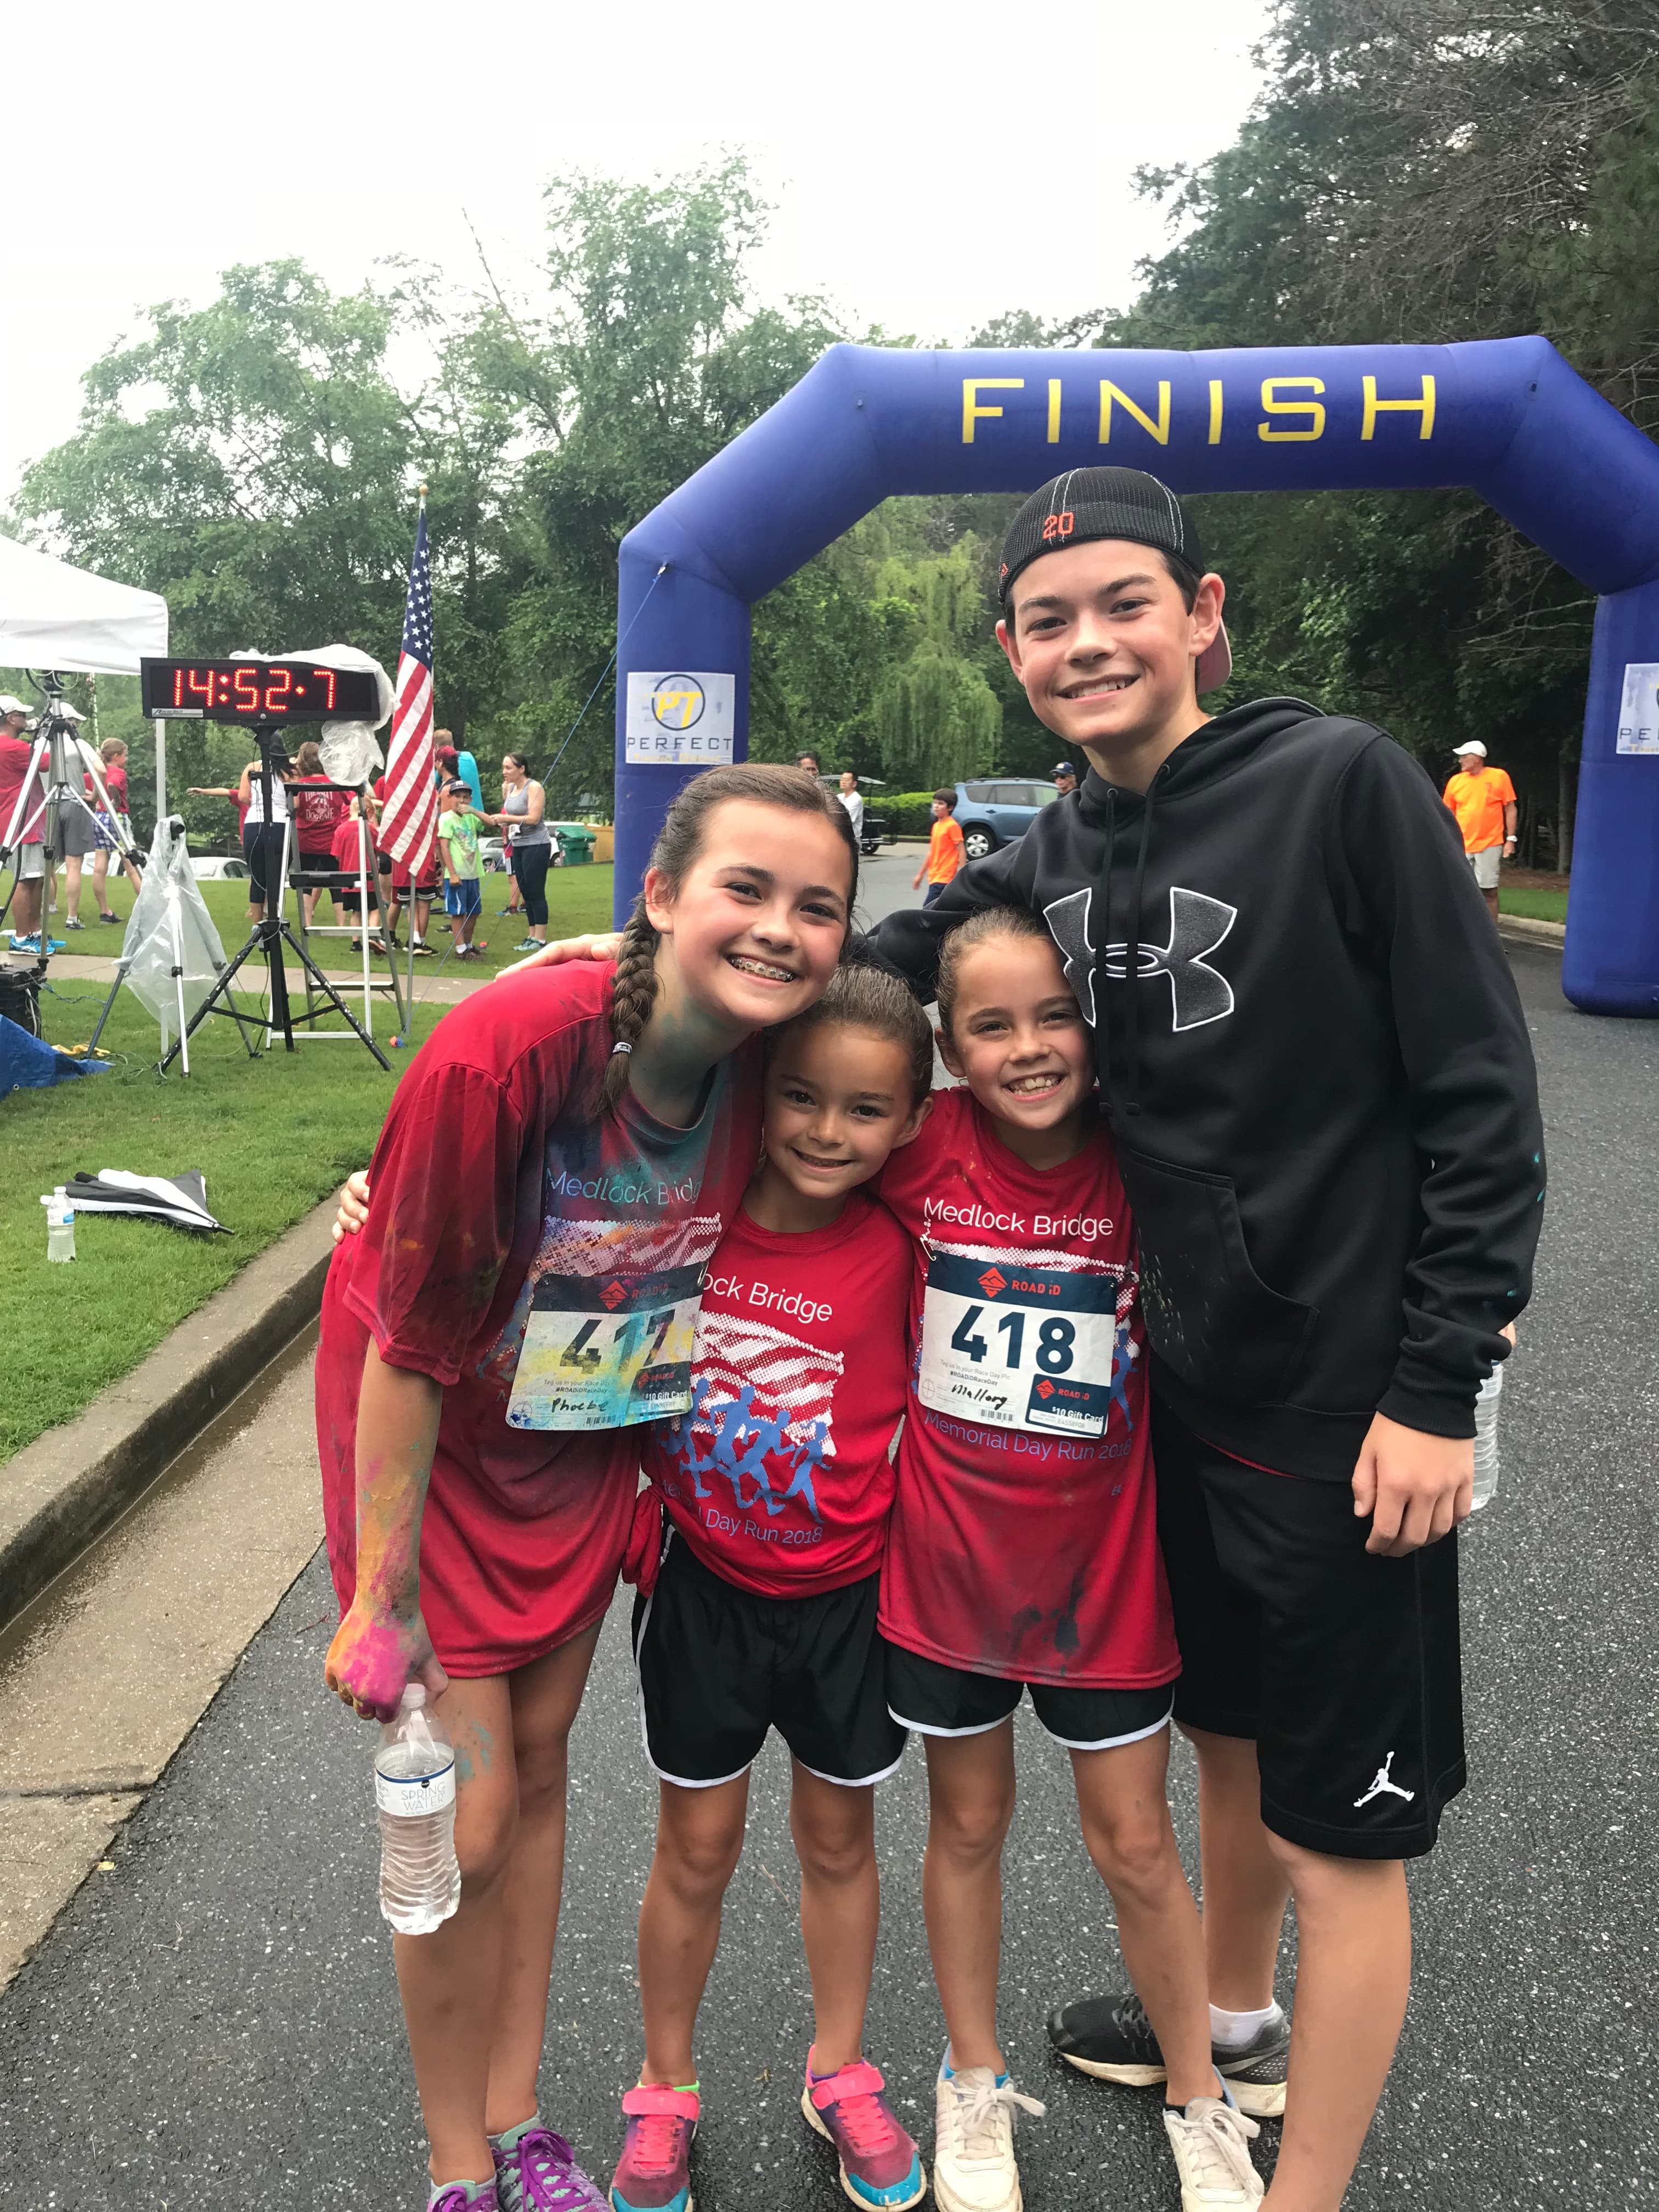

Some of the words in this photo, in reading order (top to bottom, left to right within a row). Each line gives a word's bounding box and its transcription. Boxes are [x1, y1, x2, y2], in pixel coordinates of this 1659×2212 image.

[962, 375, 1435, 445] FINISH
[1042, 511, 1074, 540] 20
[627, 737, 732, 750] PERFECT
[1619, 728, 1659, 740] PE
[546, 1167, 653, 1204] Medlock
[923, 1197, 1025, 1233] Medlock
[1032, 1213, 1114, 1242] Bridge
[1011, 1279, 1046, 1294] ROAD
[748, 1282, 833, 1324] Bridge
[560, 1309, 676, 1375] 417
[951, 1305, 1076, 1374] 418
[551, 1397, 608, 1413] Phoebe
[657, 1391, 670, 1400] Gift
[671, 1389, 687, 1399] Card
[1058, 1388, 1080, 1398] ROAD
[1052, 1406, 1066, 1417] $10
[1068, 1410, 1084, 1420] Gift
[1084, 1413, 1104, 1423] Card
[924, 1409, 1008, 1451] Memorial
[1013, 1434, 1053, 1462] Day
[1057, 1441, 1094, 1460] Run
[1098, 1438, 1132, 1459] 2018
[706, 1509, 741, 1537] Day
[744, 1519, 778, 1541] Run
[782, 1527, 823, 1544] 2018
[401, 1781, 445, 1800] SPRING
[403, 1792, 444, 1811] WATER
